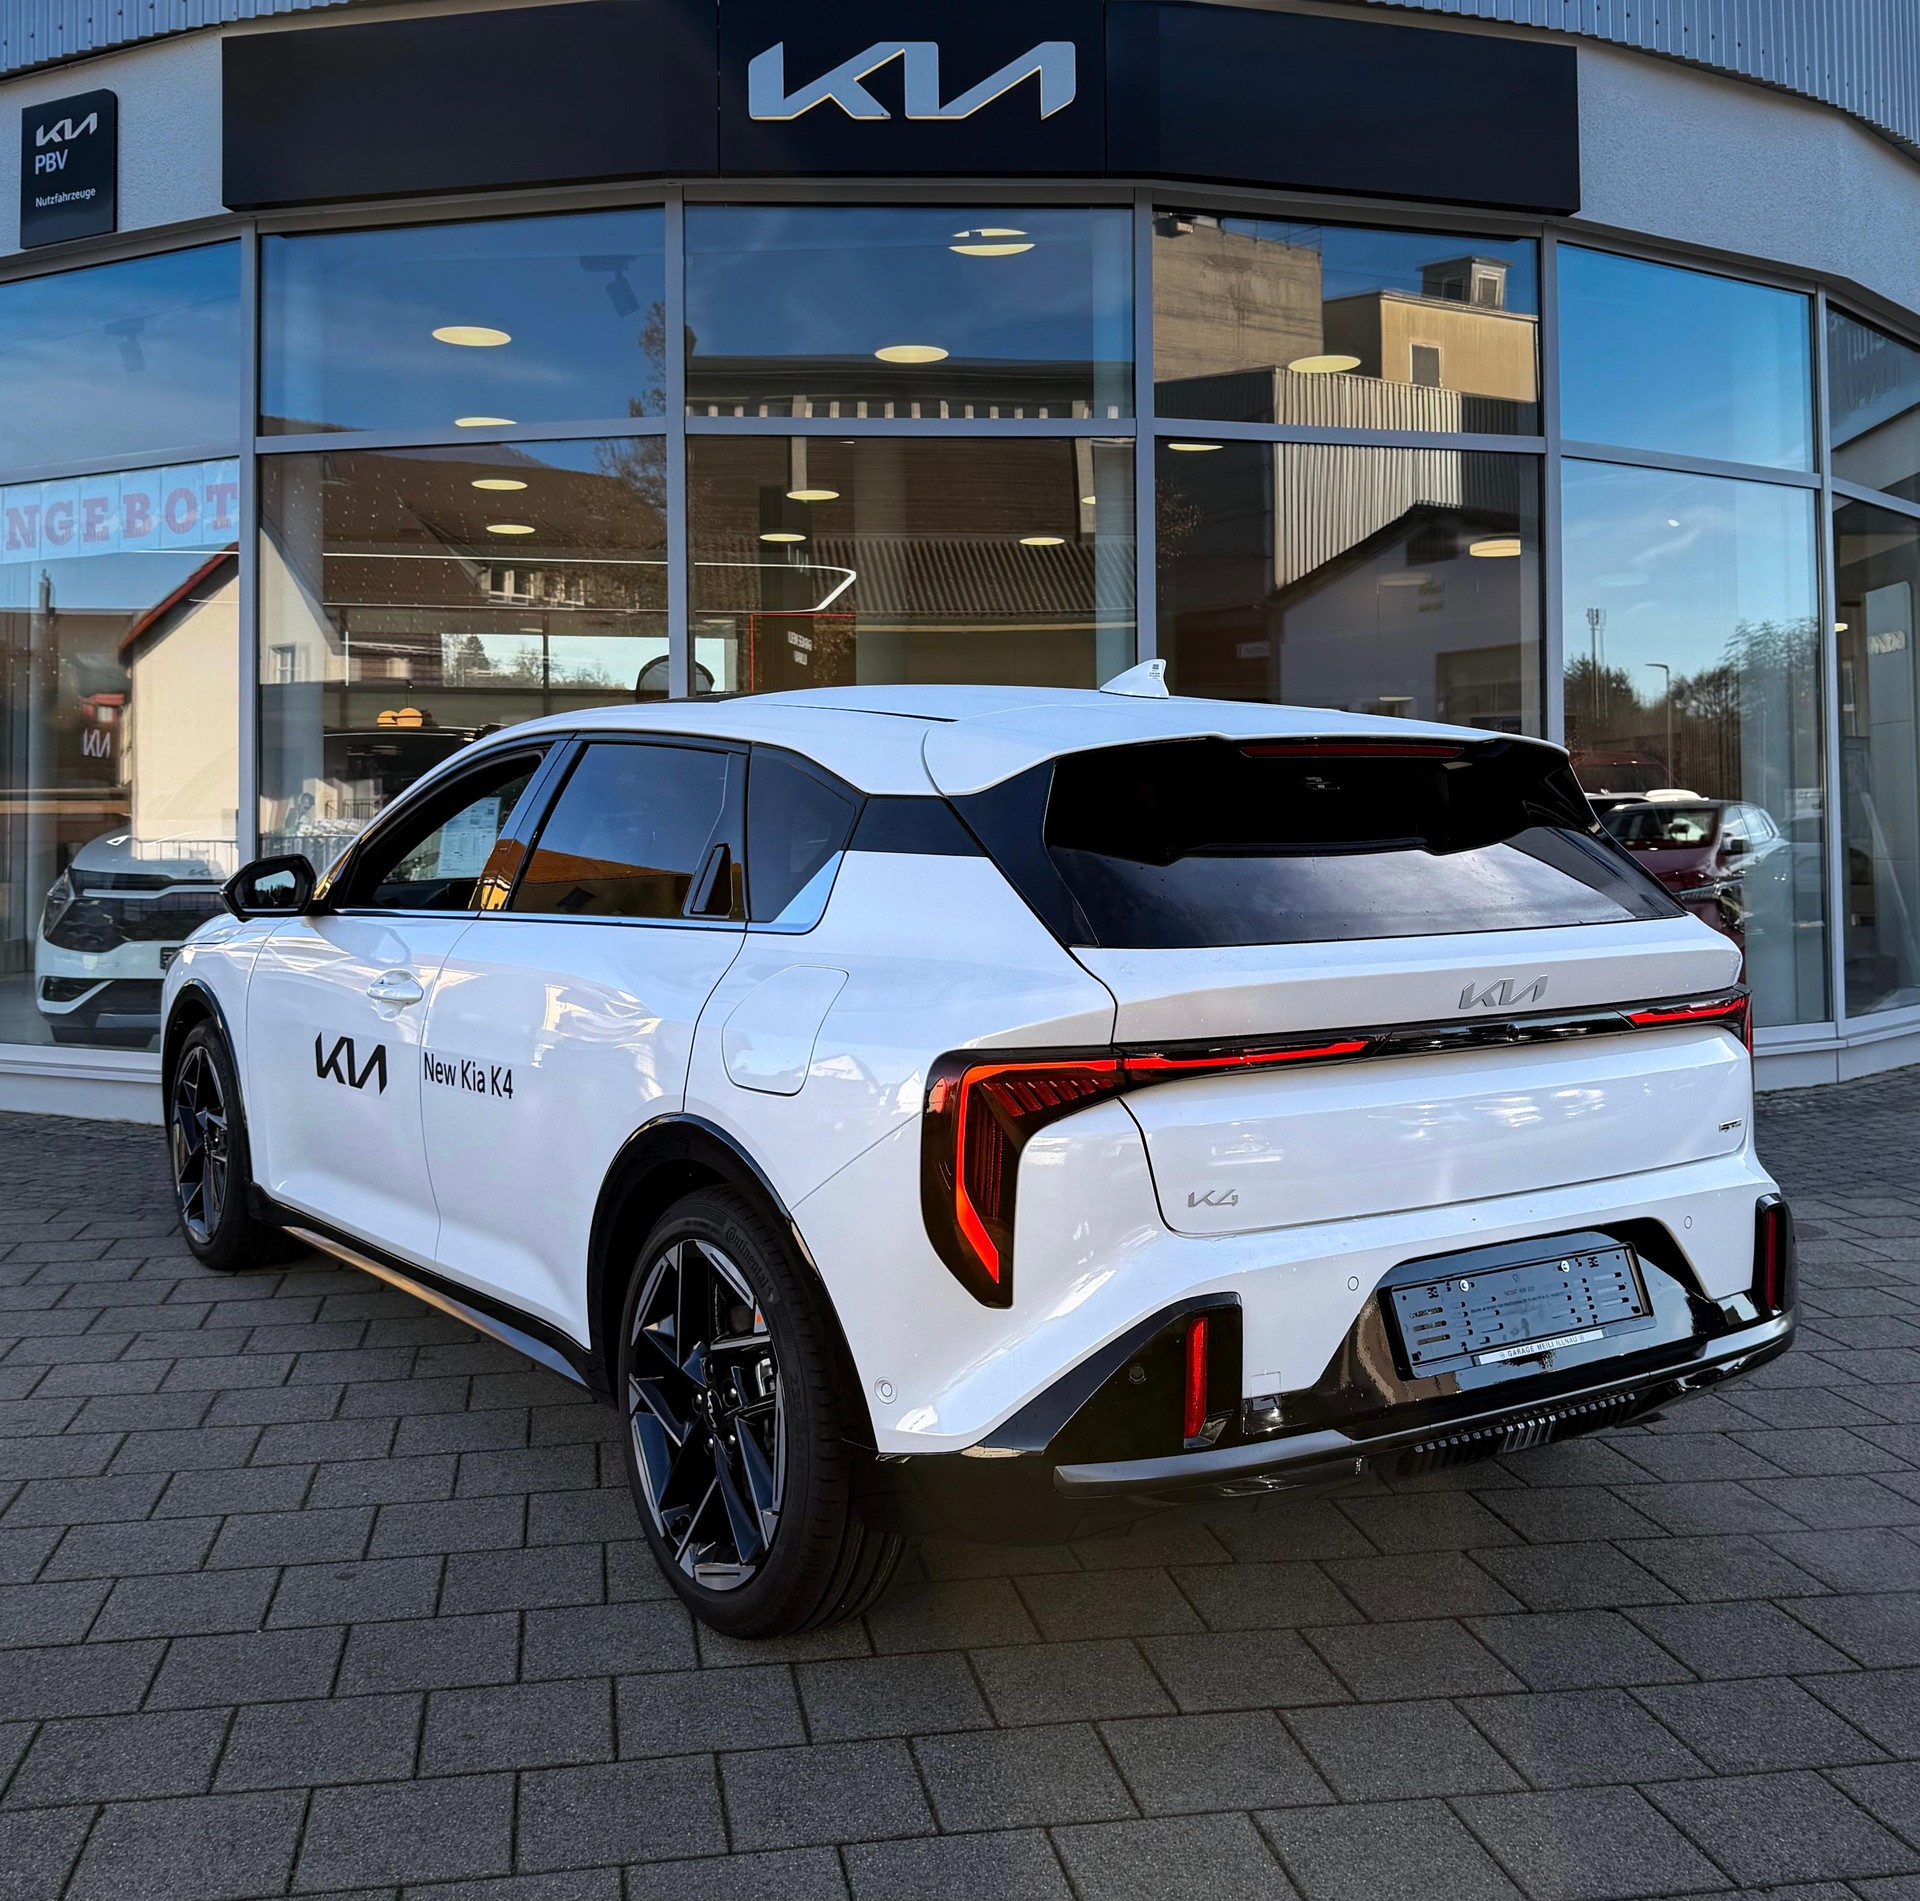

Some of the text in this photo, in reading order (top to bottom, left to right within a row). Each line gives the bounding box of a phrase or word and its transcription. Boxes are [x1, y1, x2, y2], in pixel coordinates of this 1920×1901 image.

[748, 41, 1076, 120] KIA
[36, 112, 98, 147] KIA
[35, 149, 68, 175] PBV
[35, 188, 96, 208] Nutzfahrzeuge
[1459, 974, 1548, 1010] KIA
[315, 1032, 388, 1096] KIA
[424, 1052, 514, 1100] New Kia K4
[1188, 1188, 1239, 1208] K4
[726, 1226, 770, 1289] Continental
[1507, 1346, 1535, 1358] GARAGE
